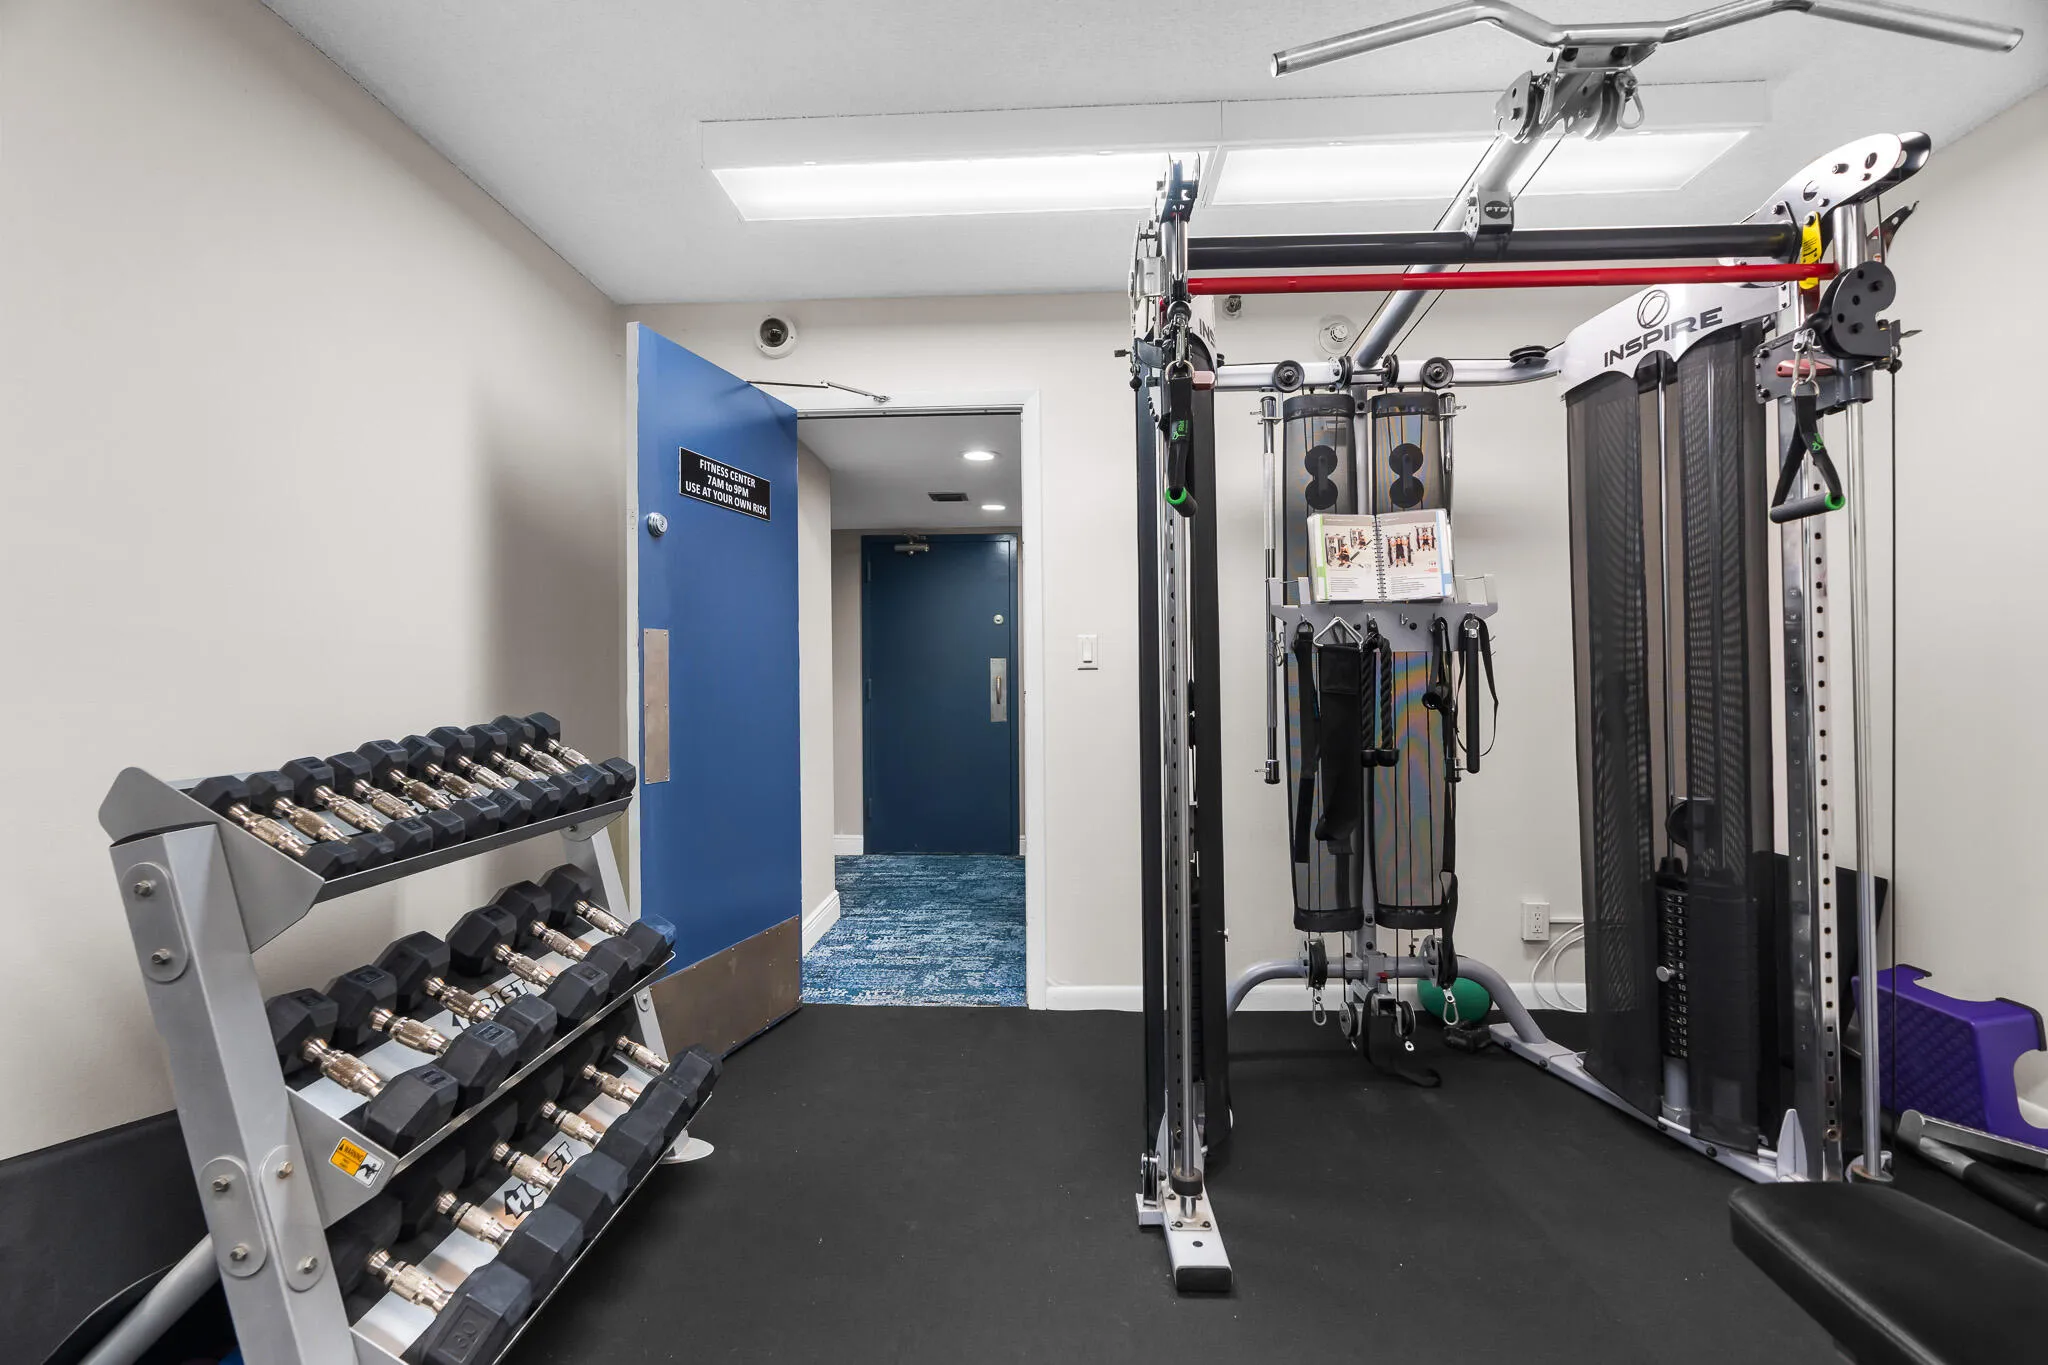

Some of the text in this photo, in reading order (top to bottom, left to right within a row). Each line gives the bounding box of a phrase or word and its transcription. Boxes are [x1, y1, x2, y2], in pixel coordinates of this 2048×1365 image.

[1604, 306, 1723, 368] INSPIRE
[699, 459, 756, 488] FITNESS CENTER
[707, 474, 749, 498] 7AM to 9PM
[685, 480, 768, 516] USE AT YOUR OWN RISK
[504, 1141, 574, 1219] HOST
